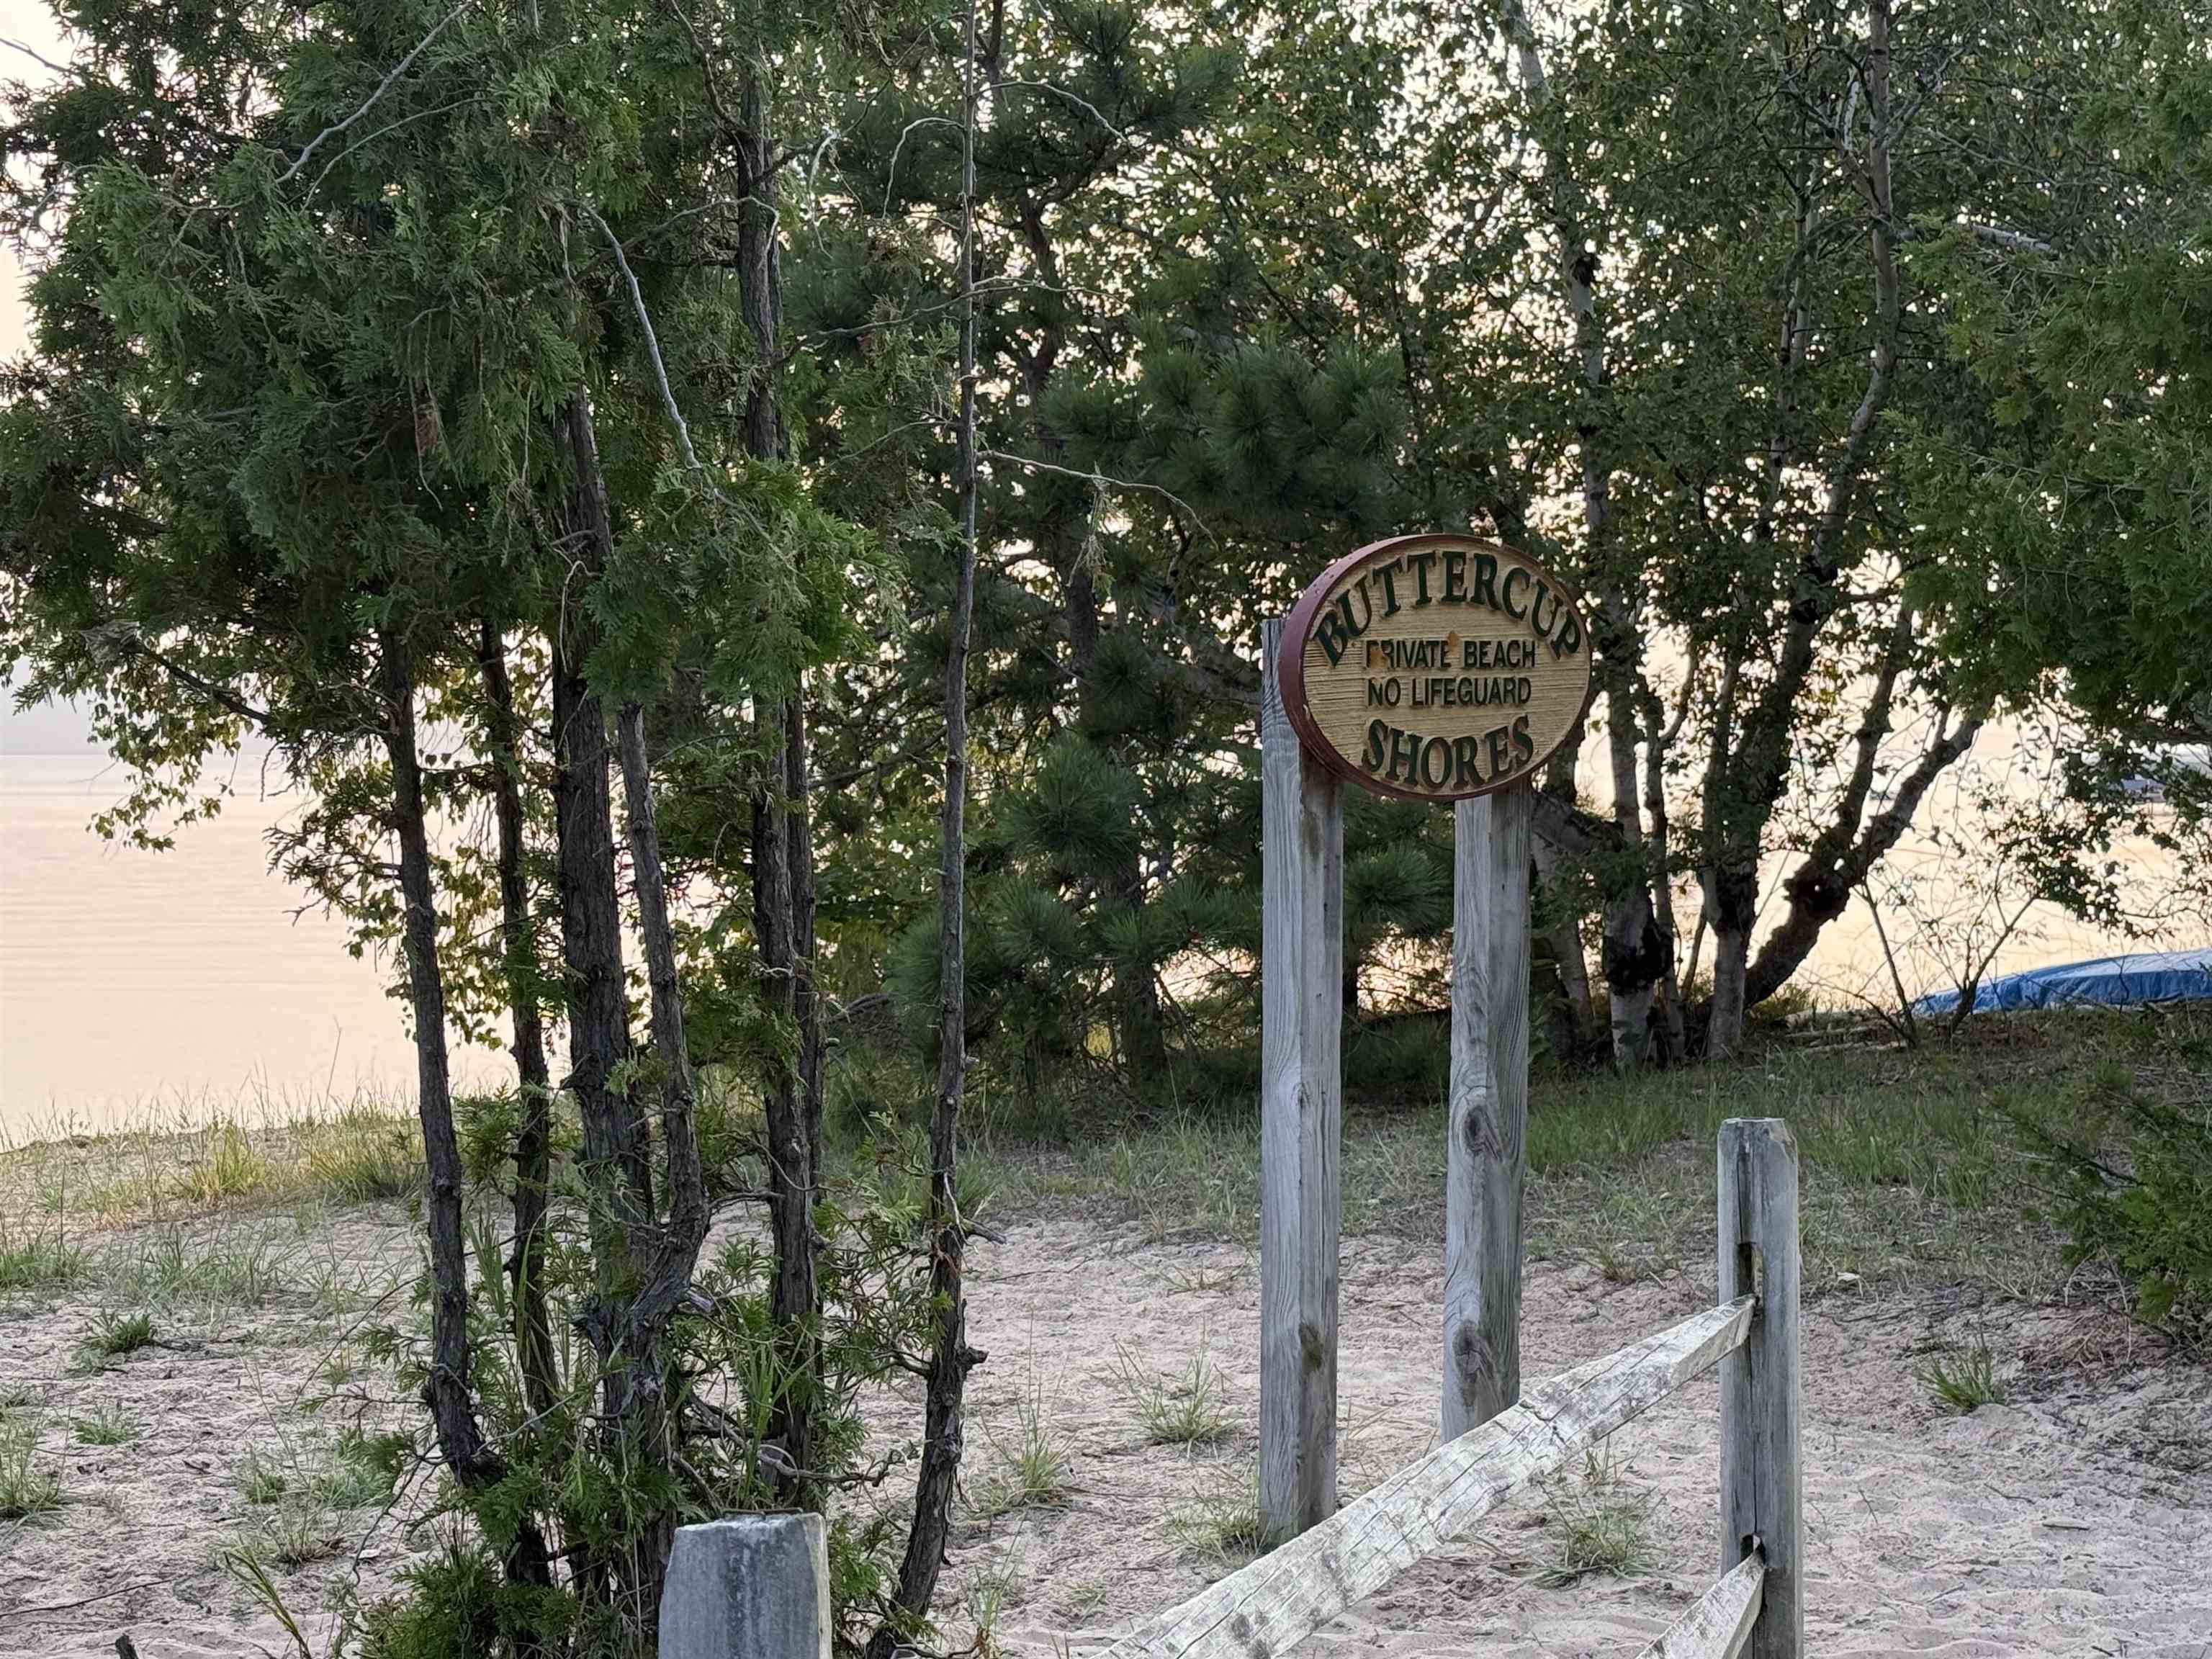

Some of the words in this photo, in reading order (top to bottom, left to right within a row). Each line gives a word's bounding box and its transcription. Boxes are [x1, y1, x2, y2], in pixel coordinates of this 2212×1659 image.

[1313, 551, 1581, 666] BUTTERCUP
[1463, 640, 1536, 668] BEACH
[1367, 677, 1401, 706] NO
[1411, 677, 1532, 706] LIFEGUARD
[1362, 715, 1534, 788] SHORES
